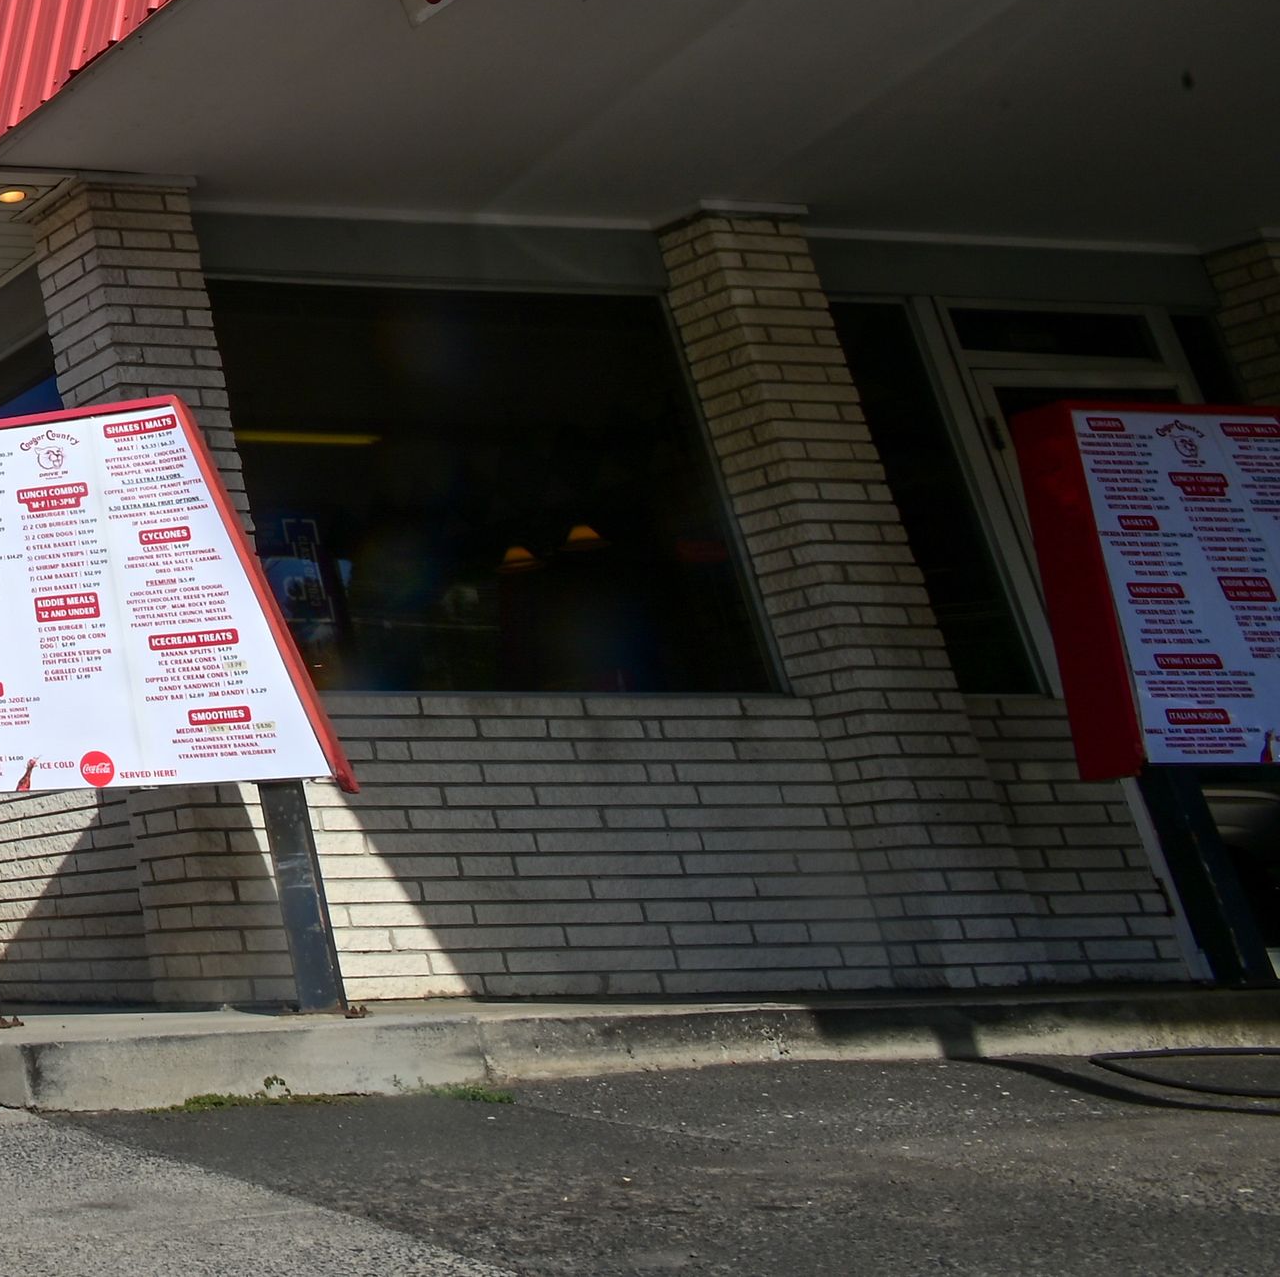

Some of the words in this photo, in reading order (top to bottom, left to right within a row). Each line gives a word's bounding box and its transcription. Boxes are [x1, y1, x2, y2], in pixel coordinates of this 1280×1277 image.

[143, 418, 171, 428] MALTS
[107, 424, 139, 434] SHAKES
[20, 434, 45, 451] Cougar
[46, 430, 79, 445] Country
[20, 490, 47, 499] LUNCH
[49, 486, 84, 495] COMBOS
[27, 511, 65, 519] HAMBURGER
[142, 530, 187, 540] CYCLONES
[38, 599, 64, 607] KIDDIE
[67, 596, 95, 604] MEALS
[152, 636, 196, 646] ICECREAM
[198, 632, 232, 642] TREATS
[192, 710, 244, 720] SMOOTHIES
[82, 762, 111, 774] Coca-Cola
